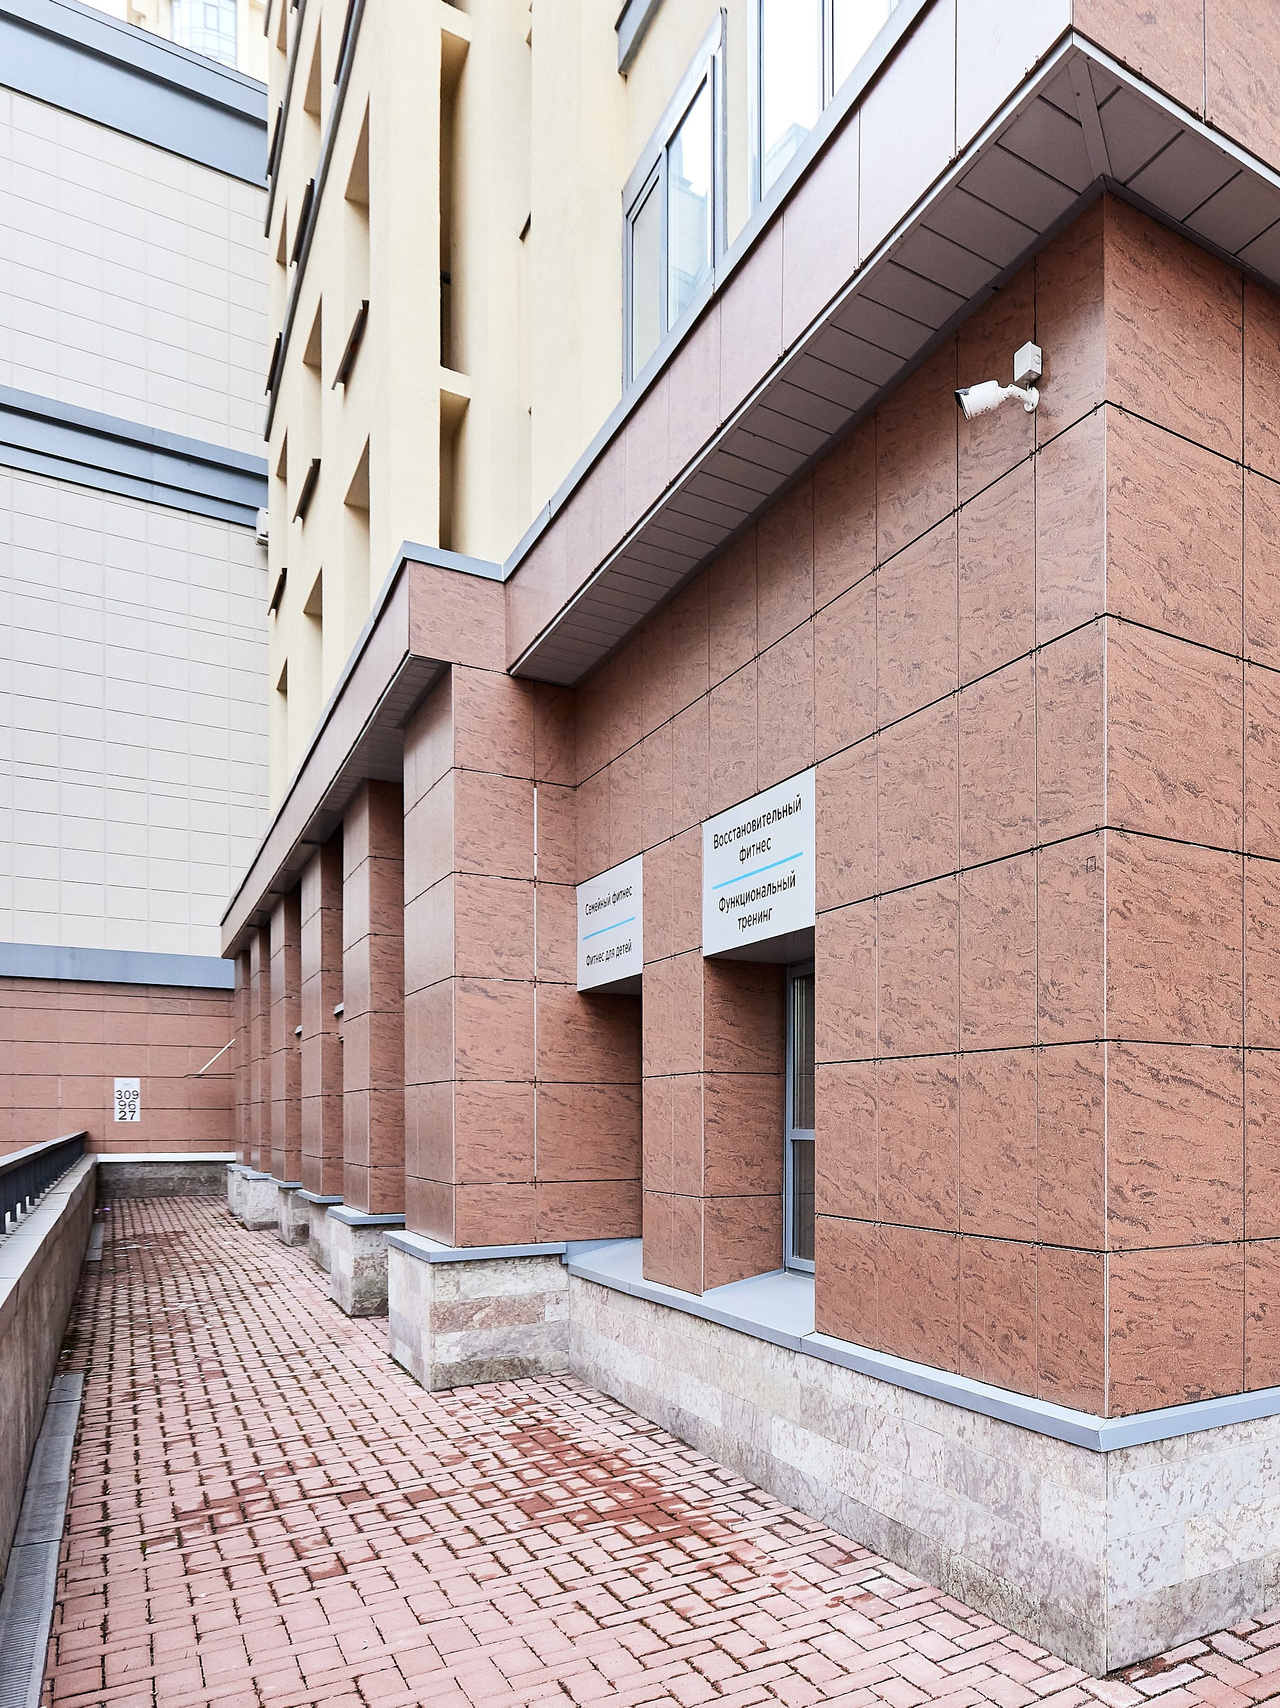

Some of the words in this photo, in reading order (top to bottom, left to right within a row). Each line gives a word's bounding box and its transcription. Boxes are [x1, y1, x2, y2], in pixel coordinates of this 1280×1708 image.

[713, 793, 802, 849] Восстановительный
[739, 837, 772, 864] фитнес
[584, 893, 612, 916] Семейный
[612, 886, 633, 906] фитнес
[718, 870, 796, 914] Функциональный
[737, 907, 773, 932] тренинг
[585, 952, 605, 967] Фитнес
[605, 947, 616, 962] для
[615, 939, 632, 958] детей
[115, 1089, 139, 1100] 309
[118, 1100, 137, 1110] 96
[118, 1110, 136, 1121] 27
